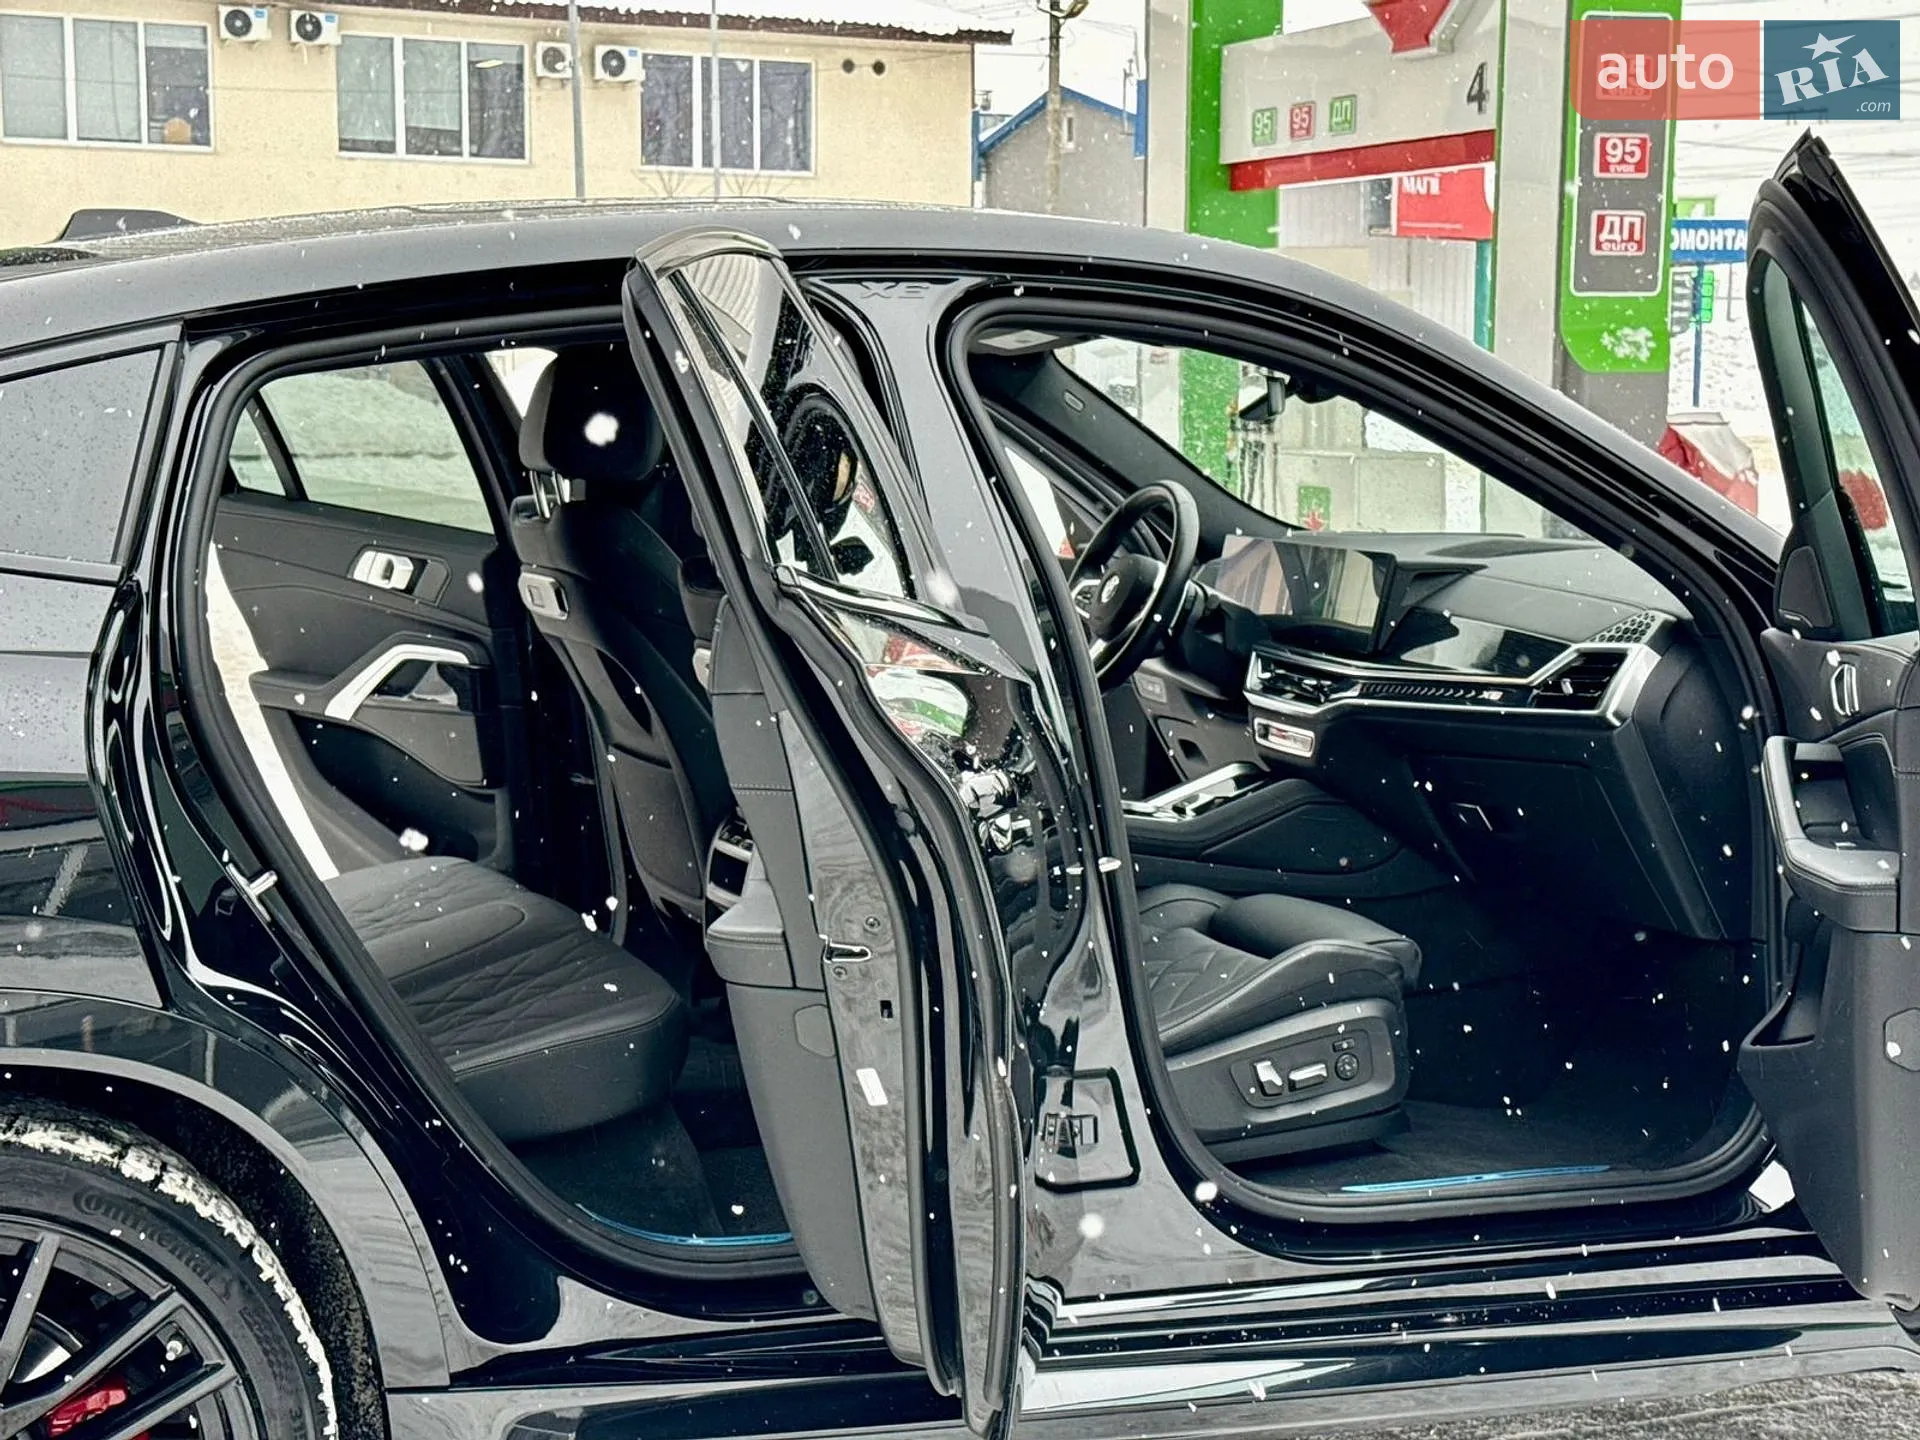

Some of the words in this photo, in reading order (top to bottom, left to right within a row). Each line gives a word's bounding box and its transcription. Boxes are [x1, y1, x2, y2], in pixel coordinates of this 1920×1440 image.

[1467, 62, 1490, 115] 4
[1254, 111, 1272, 136] 95
[1292, 106, 1309, 130] 95
[1605, 138, 1642, 164] 95
[1599, 215, 1642, 242] ДП
[1601, 241, 1638, 252] euro
